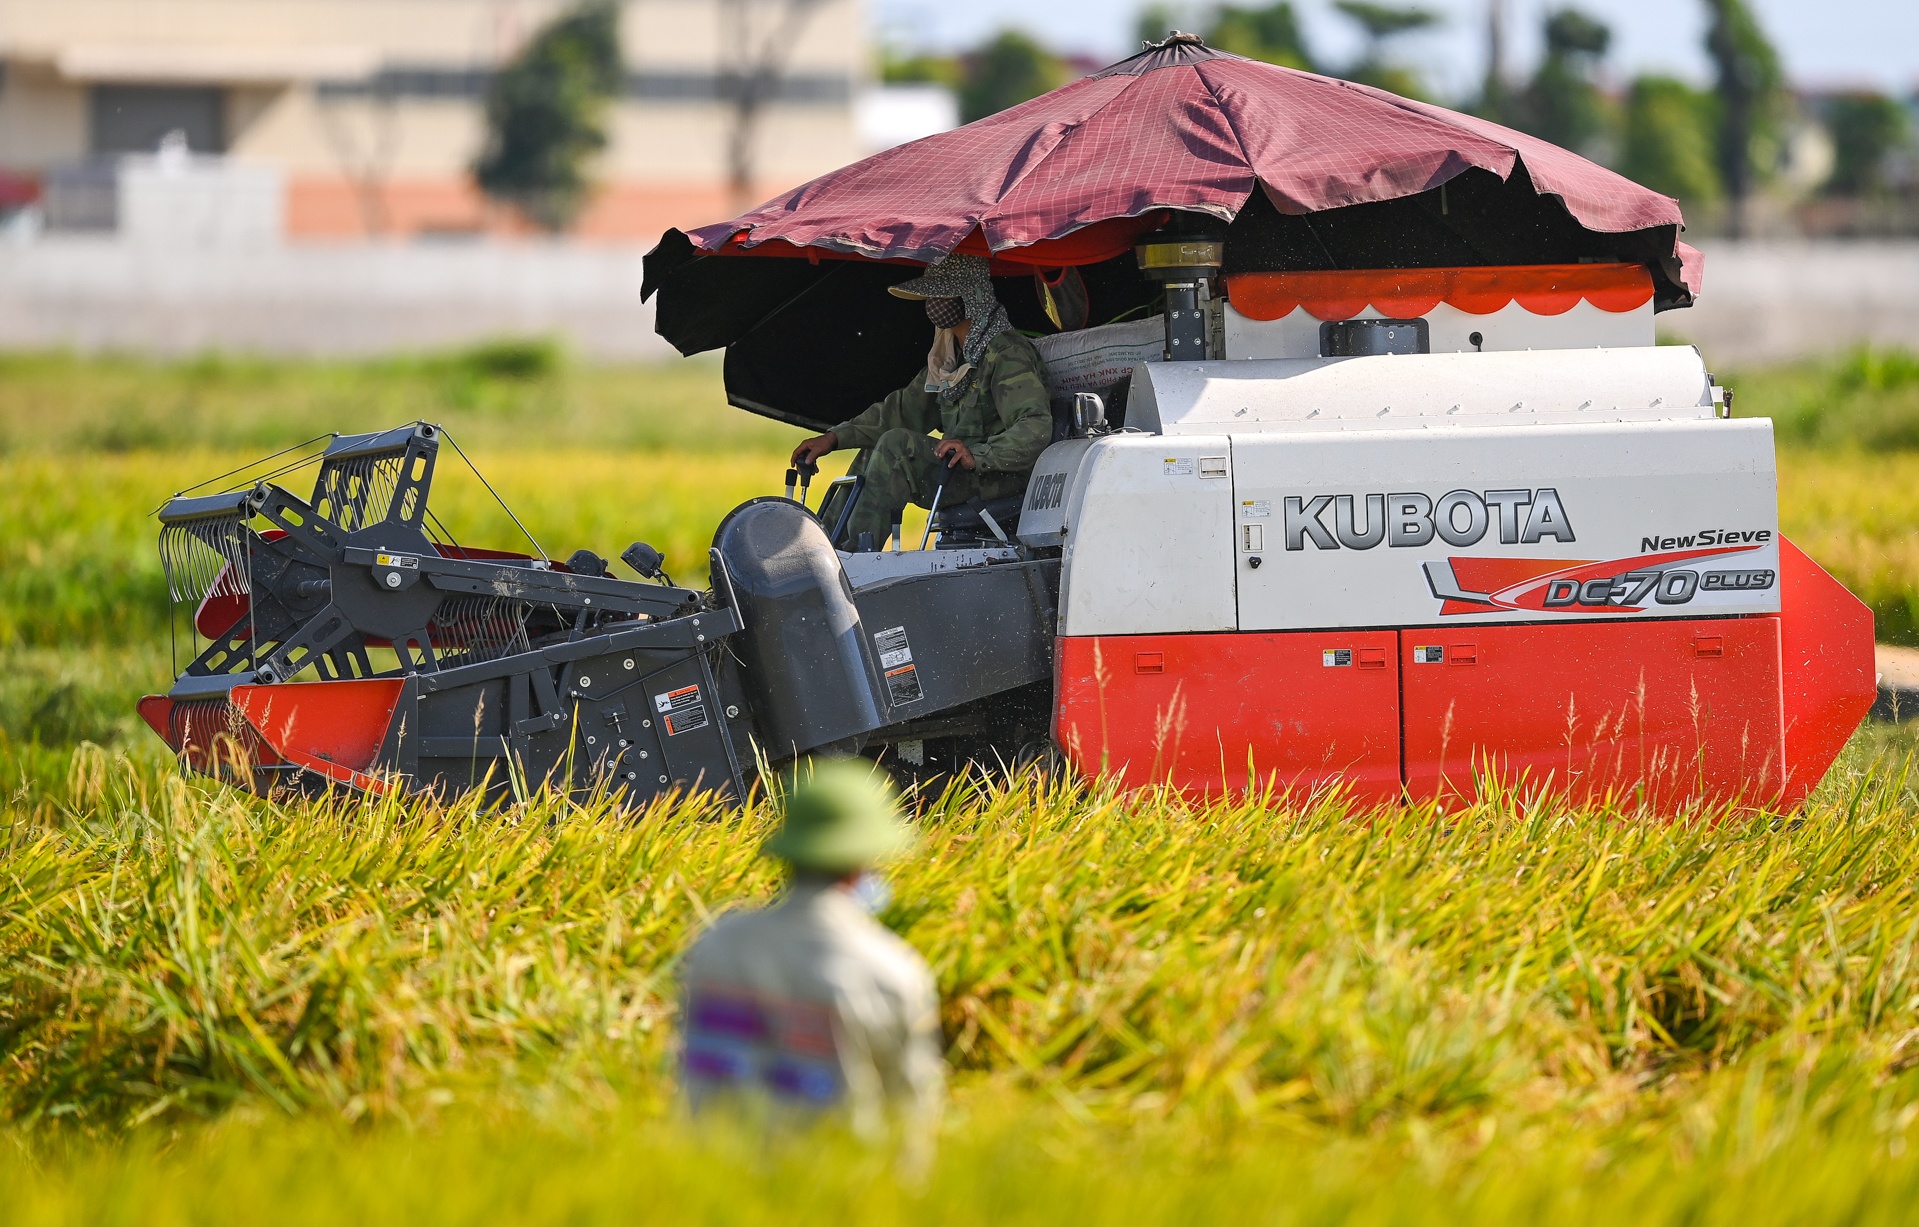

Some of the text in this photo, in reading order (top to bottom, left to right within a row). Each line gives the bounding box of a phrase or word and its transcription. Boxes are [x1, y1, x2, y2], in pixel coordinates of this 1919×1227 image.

[1028, 472, 1067, 511] KUBOTA
[1284, 488, 1576, 550] KUBOTA
[1543, 570, 1699, 607] DC-70
